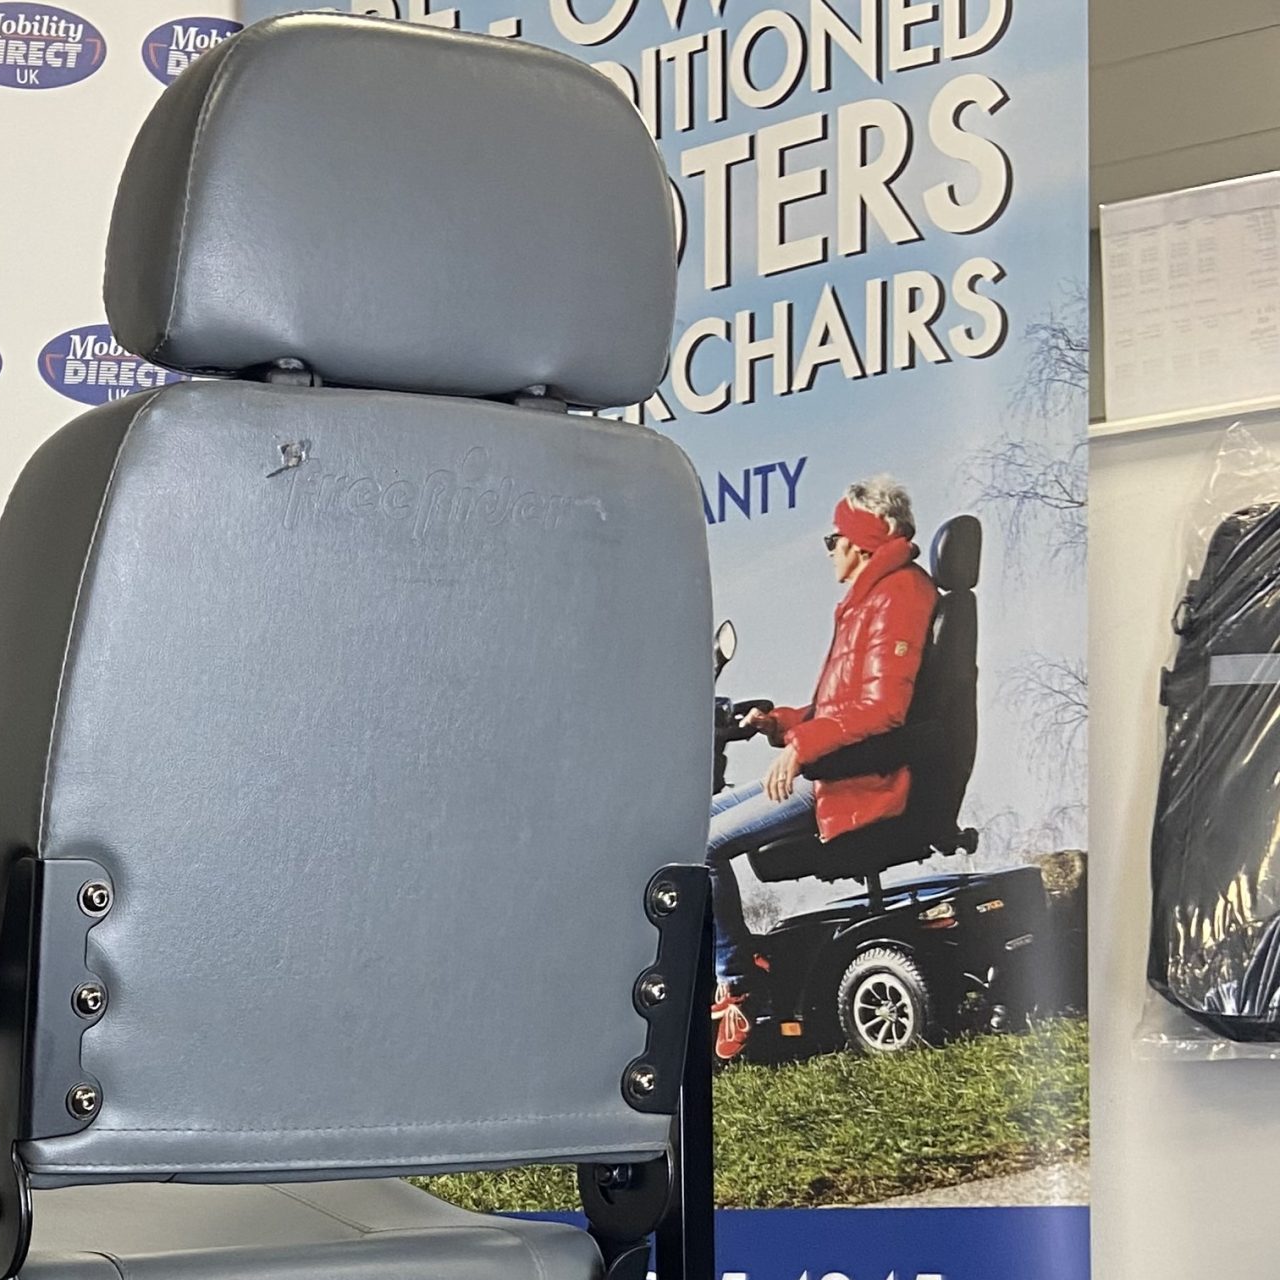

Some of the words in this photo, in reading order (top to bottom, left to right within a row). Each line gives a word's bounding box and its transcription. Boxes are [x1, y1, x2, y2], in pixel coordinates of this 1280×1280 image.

[17, 69, 39, 84] UK
[671, 74, 1013, 292] TERS
[64, 361, 167, 387] DIRECT
[602, 257, 1009, 424] CHAIRS
